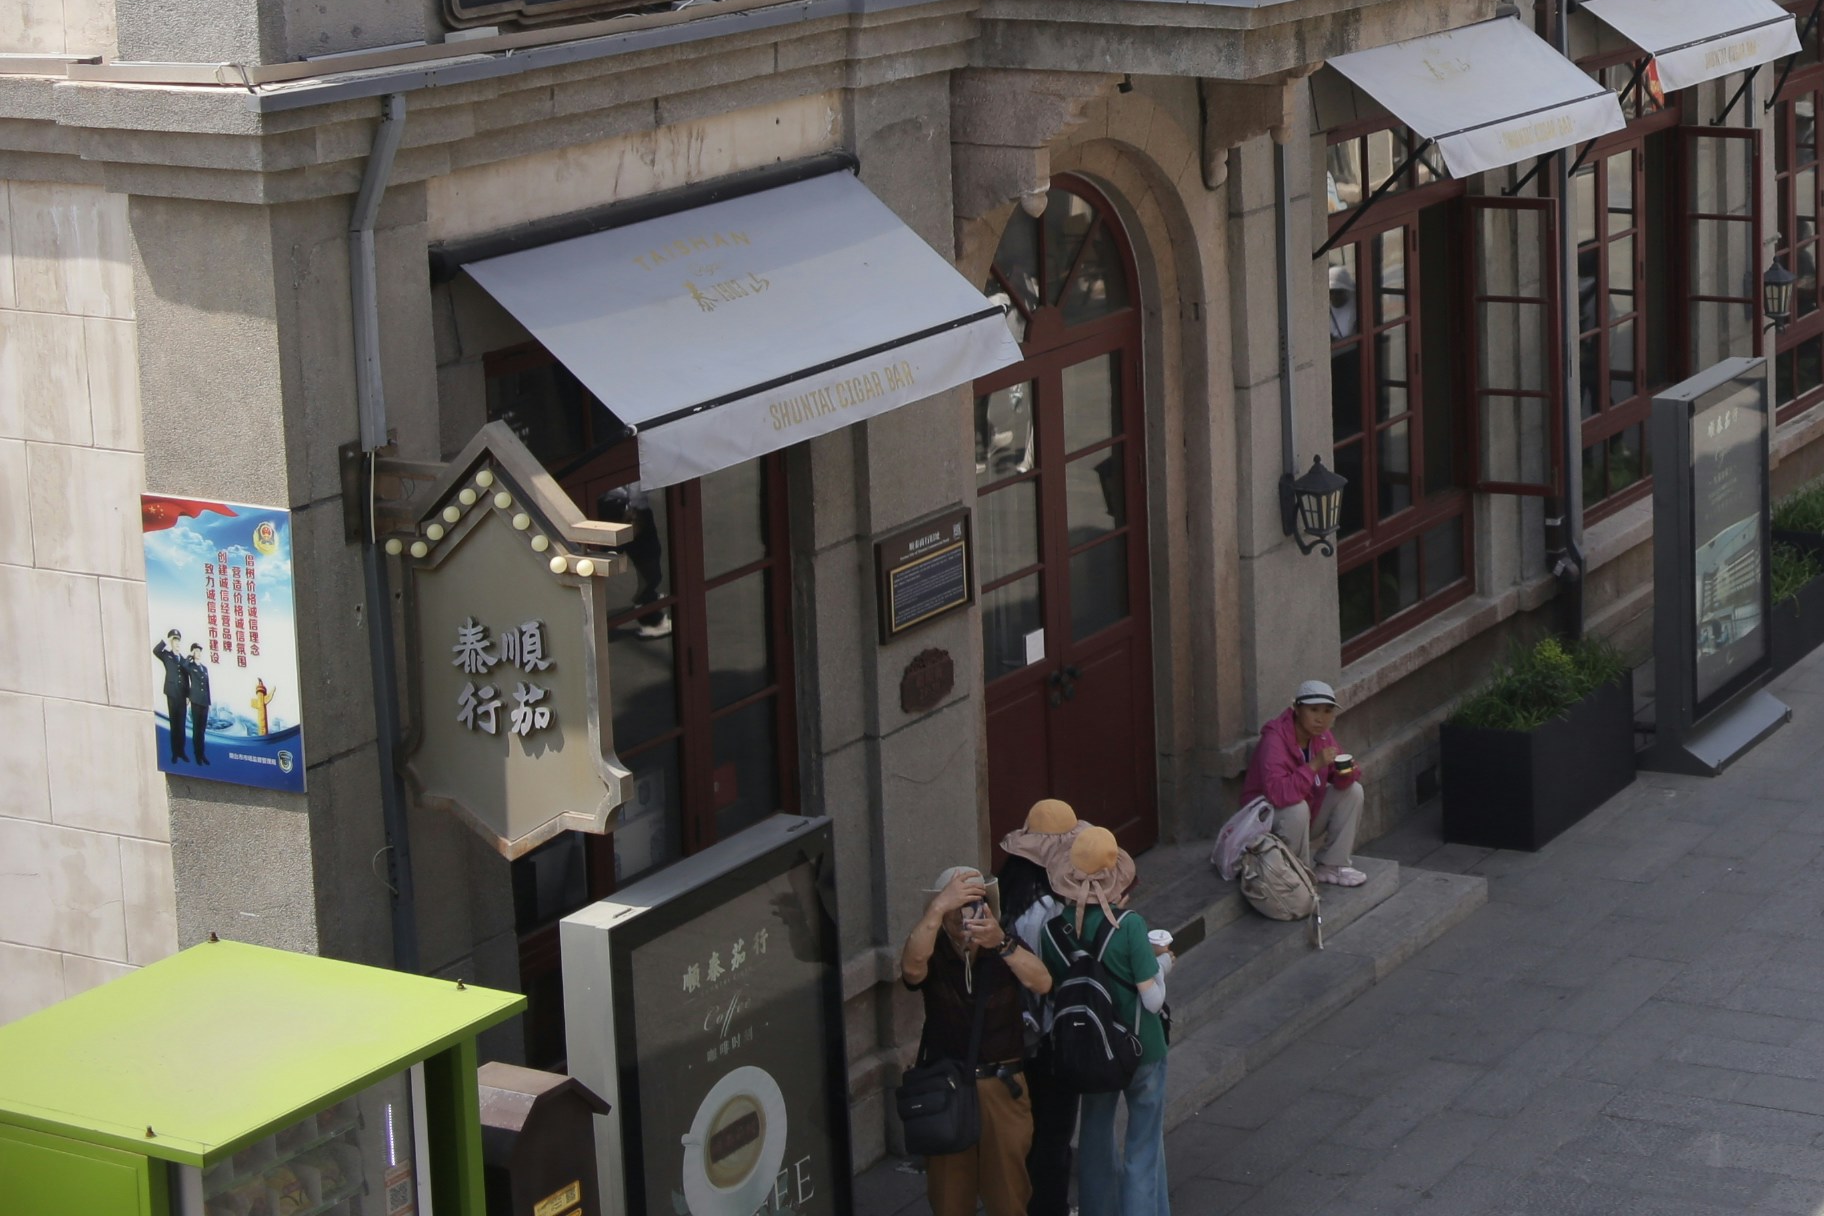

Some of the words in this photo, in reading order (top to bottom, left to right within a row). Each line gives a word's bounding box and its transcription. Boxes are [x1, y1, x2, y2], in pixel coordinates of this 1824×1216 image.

[633, 230, 753, 272] TAISHAN
[768, 387, 838, 431] SHUNTAI
[836, 372, 883, 409] CIGAR
[886, 359, 915, 395] BAR
[204, 563, 220, 664] 致力诚信城市建设
[218, 551, 233, 652] 创建诚信经营品牌
[232, 566, 247, 668] 营造价格诚信氛围
[245, 554, 260, 656] 倡树价格诚信理念
